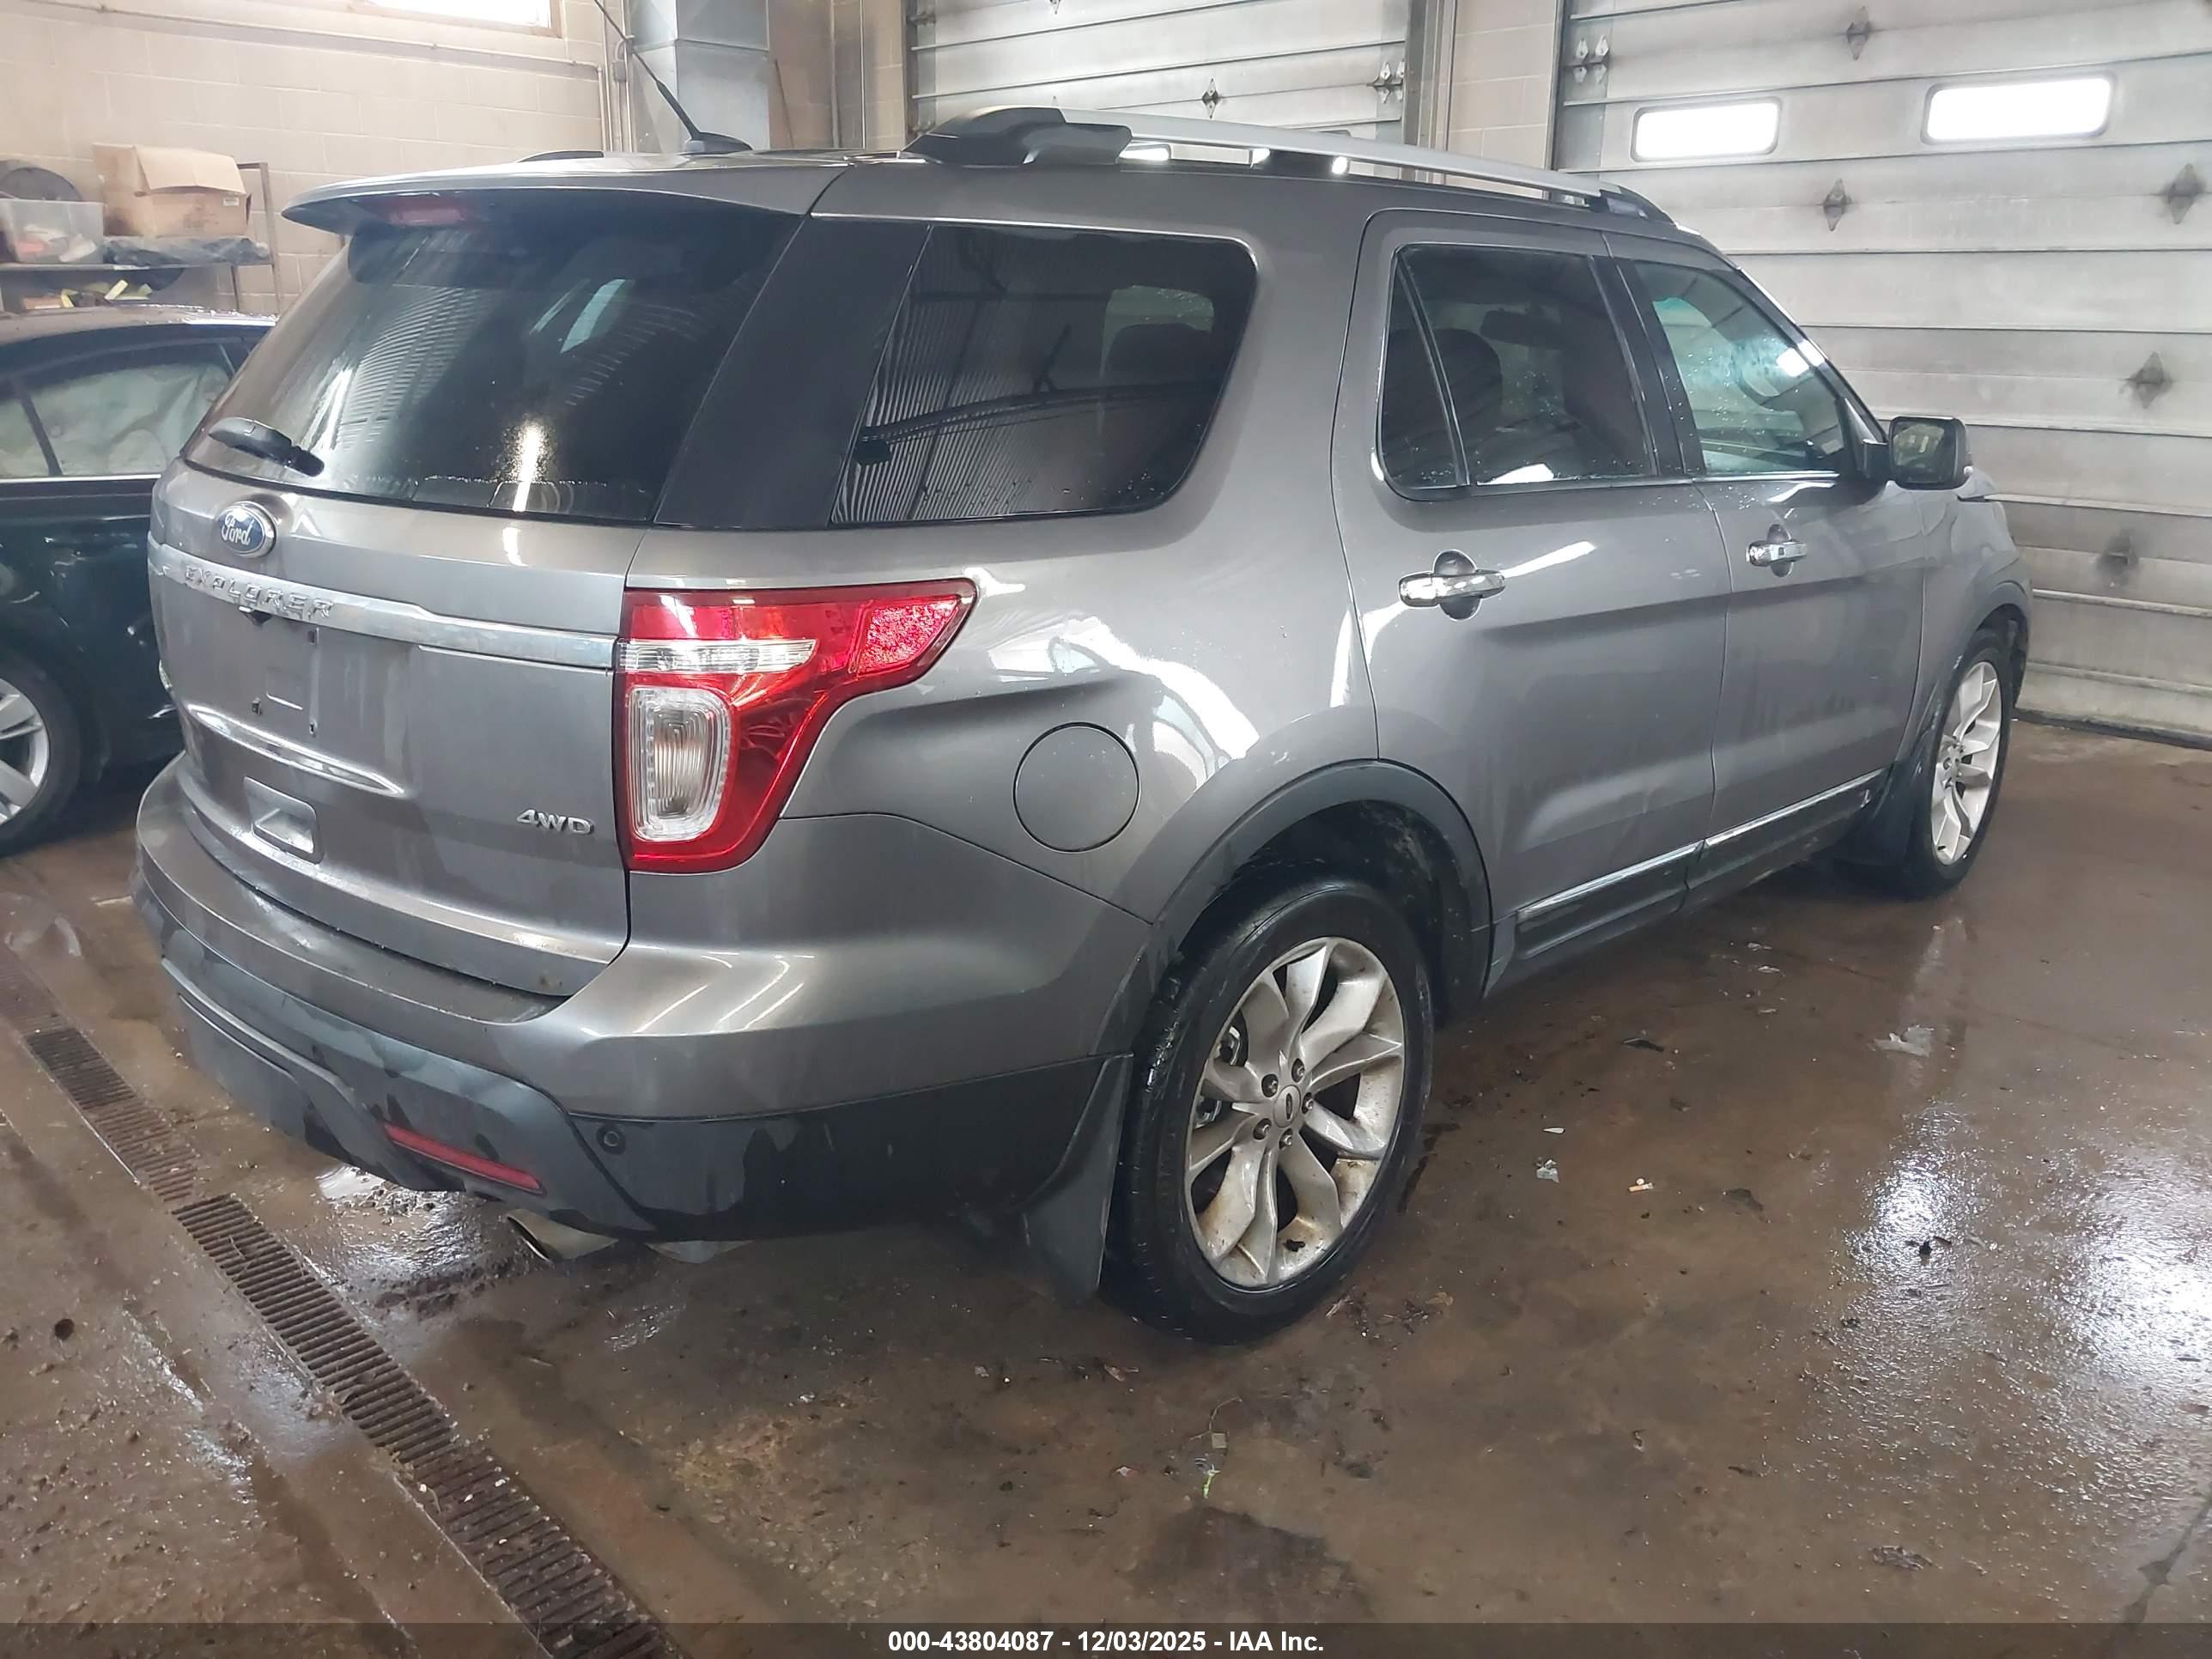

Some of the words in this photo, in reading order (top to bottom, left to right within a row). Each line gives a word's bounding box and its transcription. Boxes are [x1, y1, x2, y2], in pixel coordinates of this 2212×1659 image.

[221, 515, 255, 546] Ford
[185, 565, 335, 619] EXPLORER
[516, 808, 594, 835] 4WD
